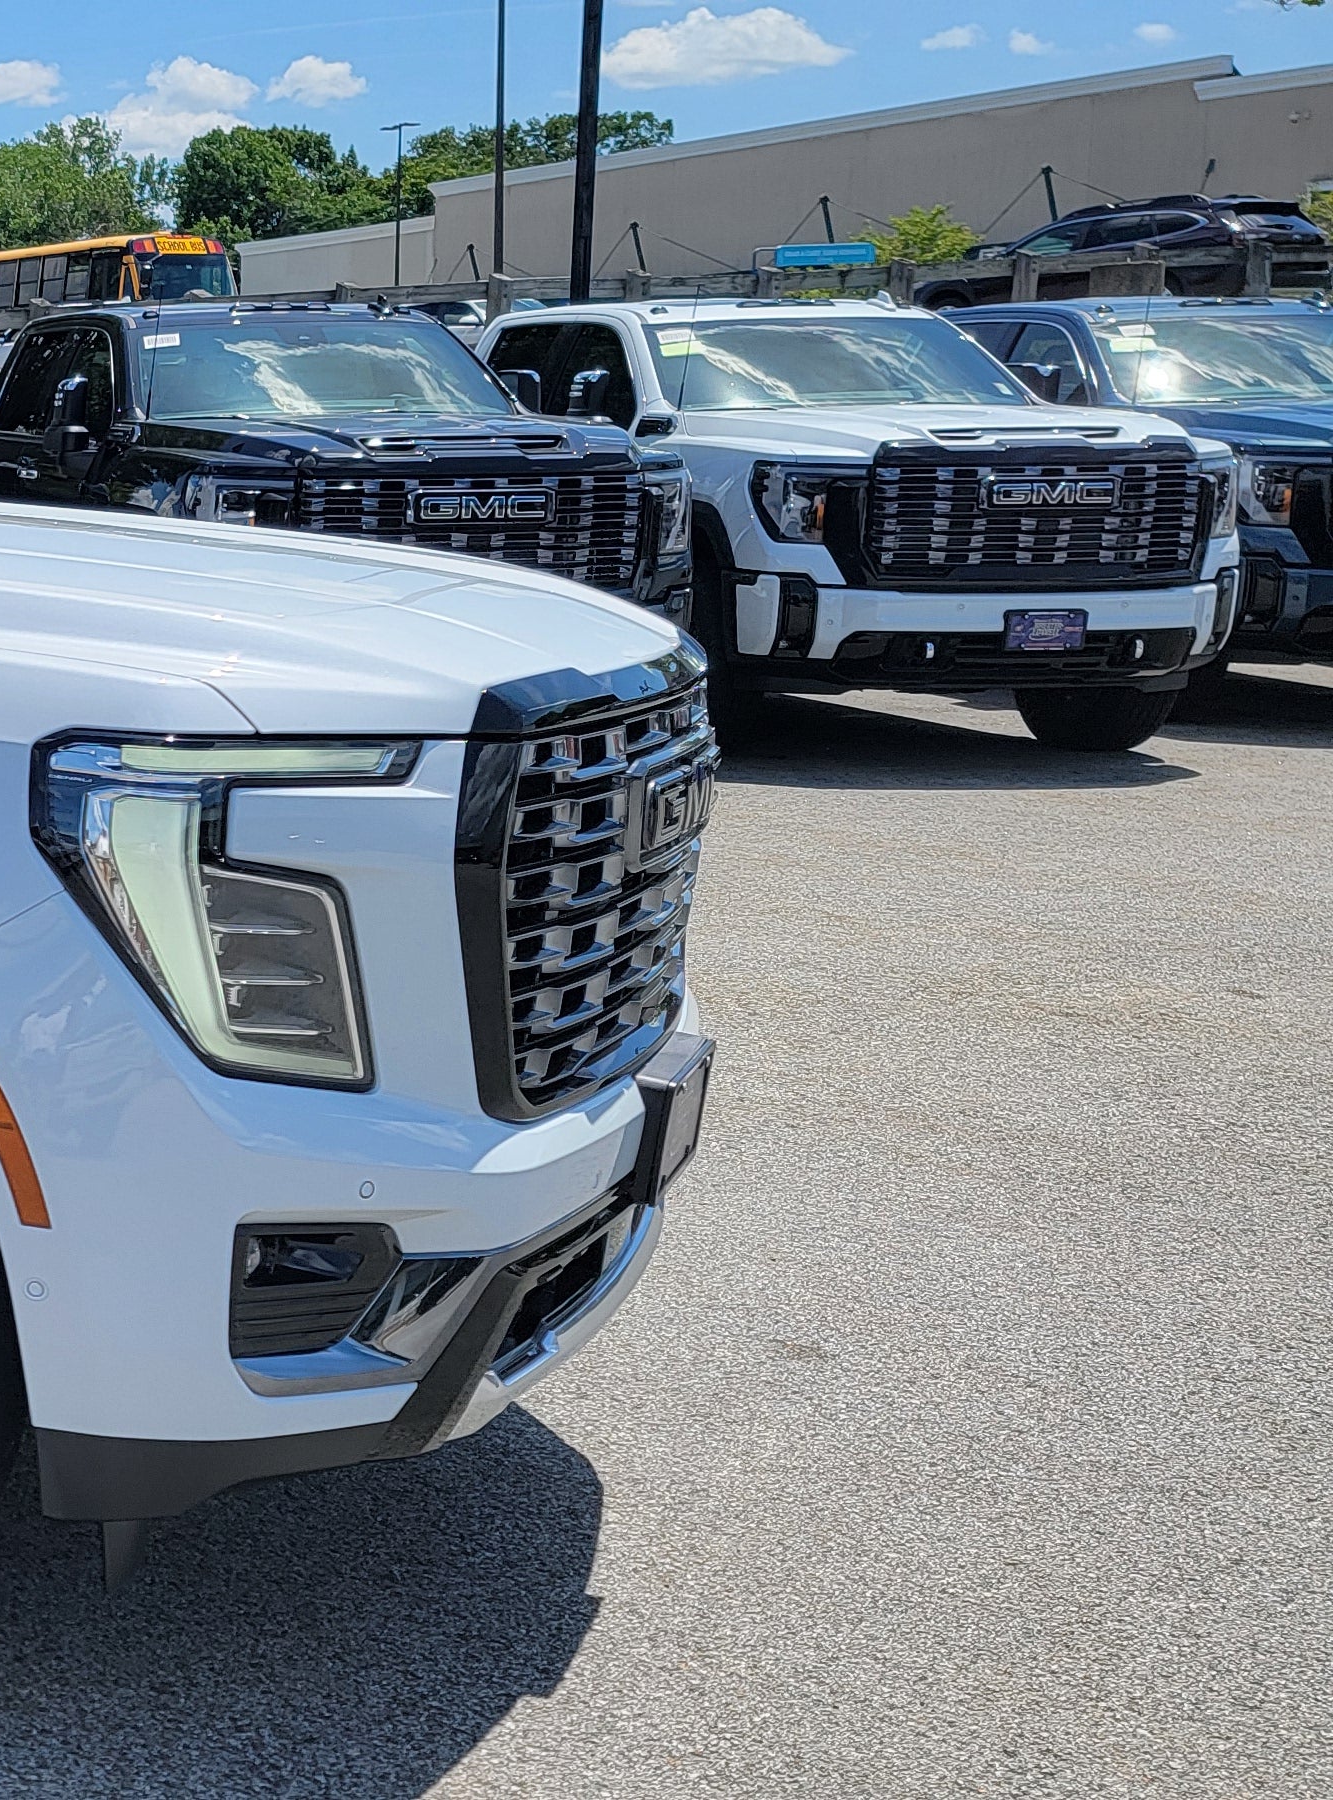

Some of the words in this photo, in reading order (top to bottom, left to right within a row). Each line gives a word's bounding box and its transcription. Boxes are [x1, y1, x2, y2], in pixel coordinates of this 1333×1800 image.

[157, 240, 190, 252] SCHOOL
[191, 240, 206, 252] BUS
[993, 482, 1113, 505] GMC
[420, 495, 546, 520] GMC
